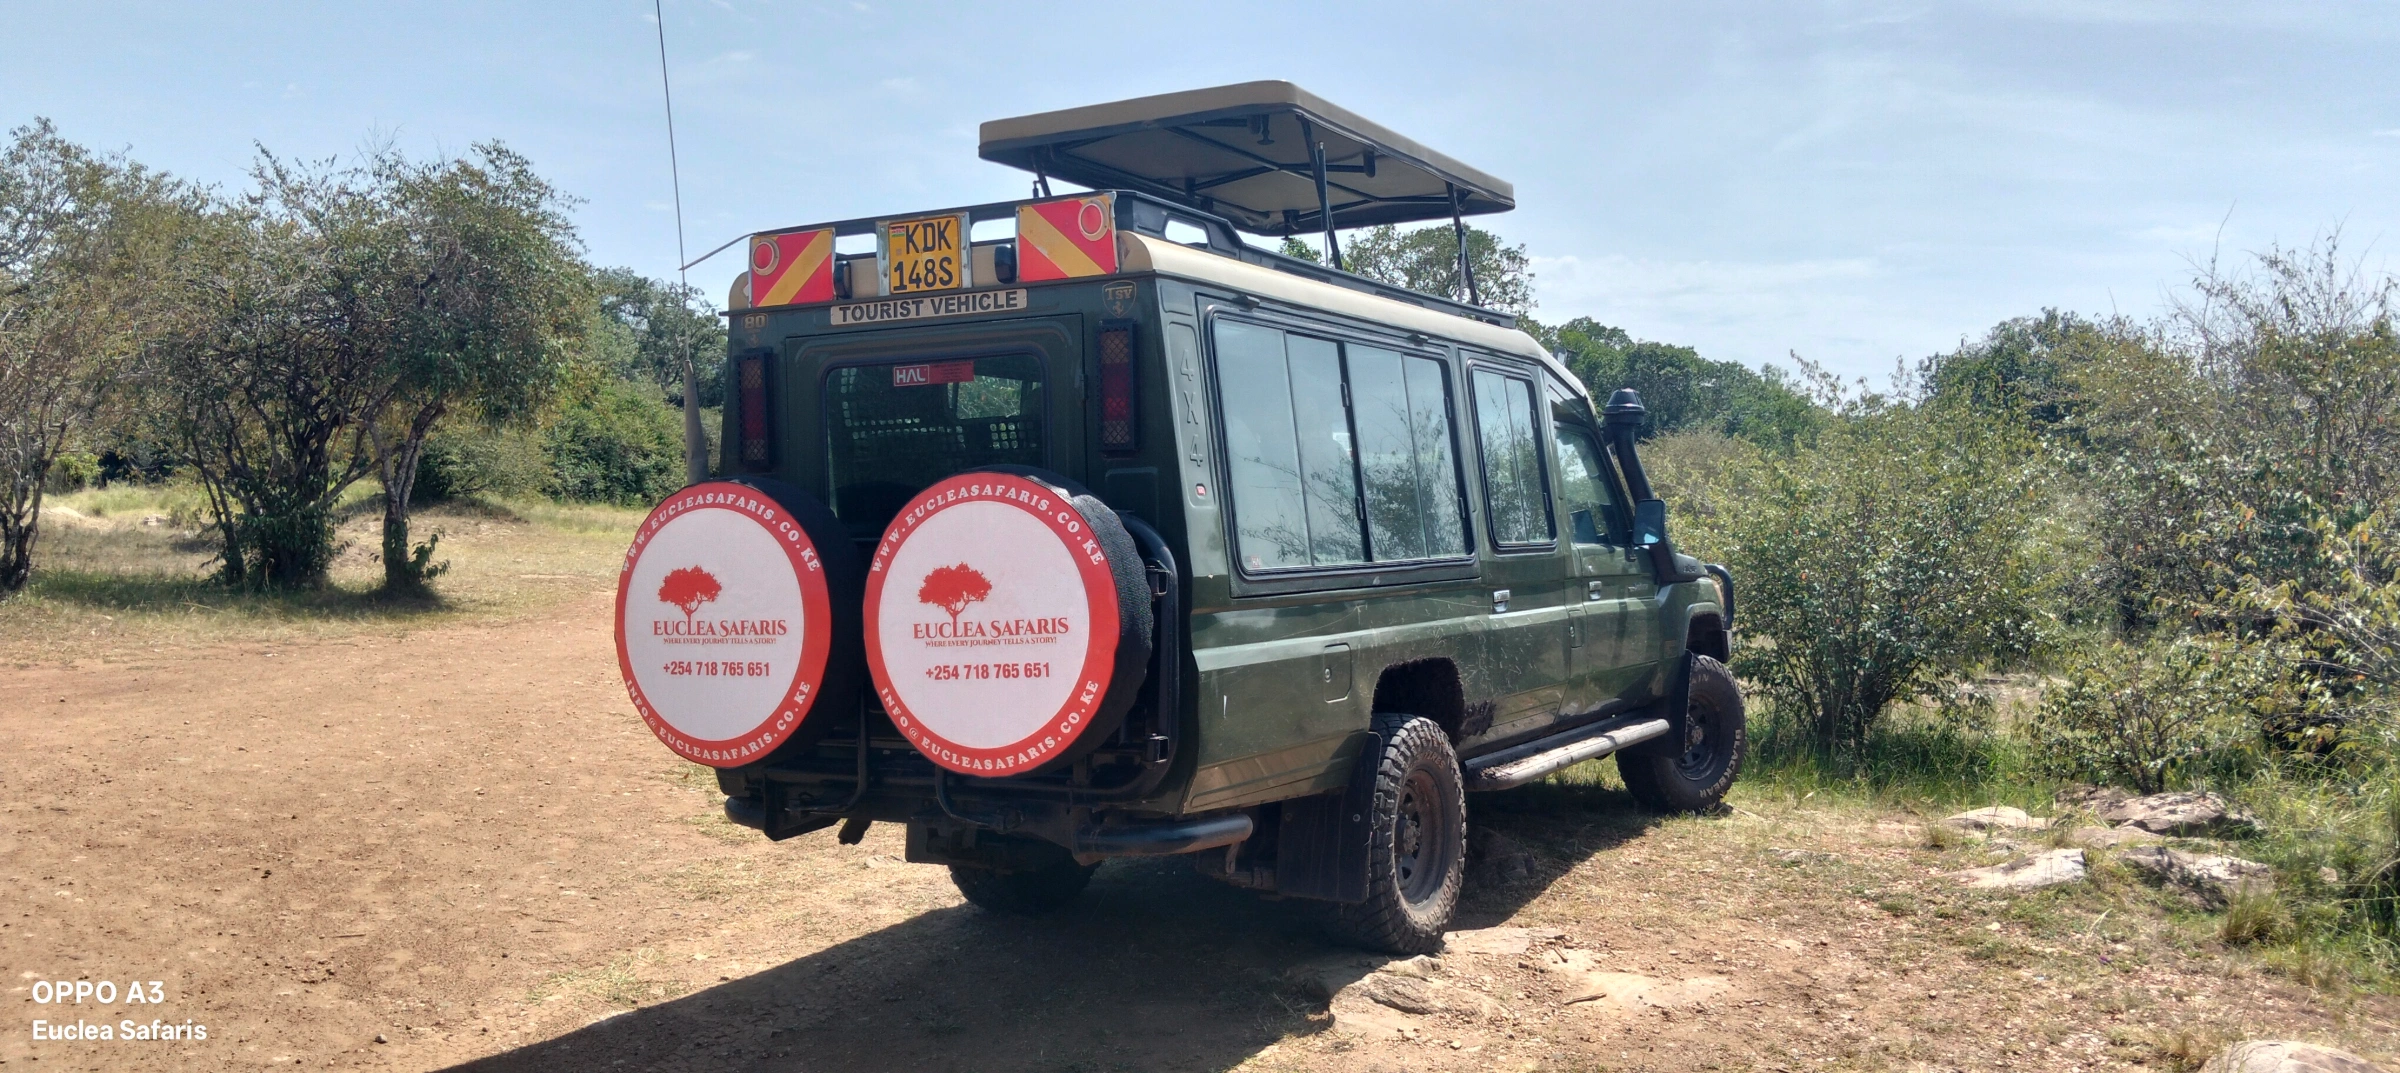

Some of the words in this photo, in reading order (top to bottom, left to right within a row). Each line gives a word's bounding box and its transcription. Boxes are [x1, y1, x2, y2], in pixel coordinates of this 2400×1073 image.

[905, 220, 952, 254] KDK
[893, 256, 954, 291] 148S
[839, 299, 924, 322] TOURIST
[930, 291, 1018, 315] VEHICLE
[744, 315, 766, 329] 80
[622, 492, 820, 572] WWW.EUCLEASAFARIS.CO.KE
[872, 484, 1105, 573] WWW.EUCLEASAFARIS.CO.KE
[653, 620, 717, 636] EUCLEA
[719, 619, 787, 638] SAFARIS
[913, 620, 987, 639] EUCLEA
[990, 617, 1069, 639] SAFARIS
[701, 637, 729, 645] JOURNEY
[925, 640, 947, 648] WHERE
[948, 639, 968, 647] EVERY
[970, 638, 1001, 647] JOURNEY
[1003, 637, 1024, 645] TELLS
[1031, 636, 1057, 644] STORY!
[663, 661, 692, 675] +254
[696, 661, 718, 676] 718
[721, 661, 744, 676] 765
[747, 662, 770, 677] 651
[926, 665, 960, 680] +254
[963, 664, 990, 679] 718
[993, 663, 1020, 679] 765
[1024, 662, 1050, 678] 651
